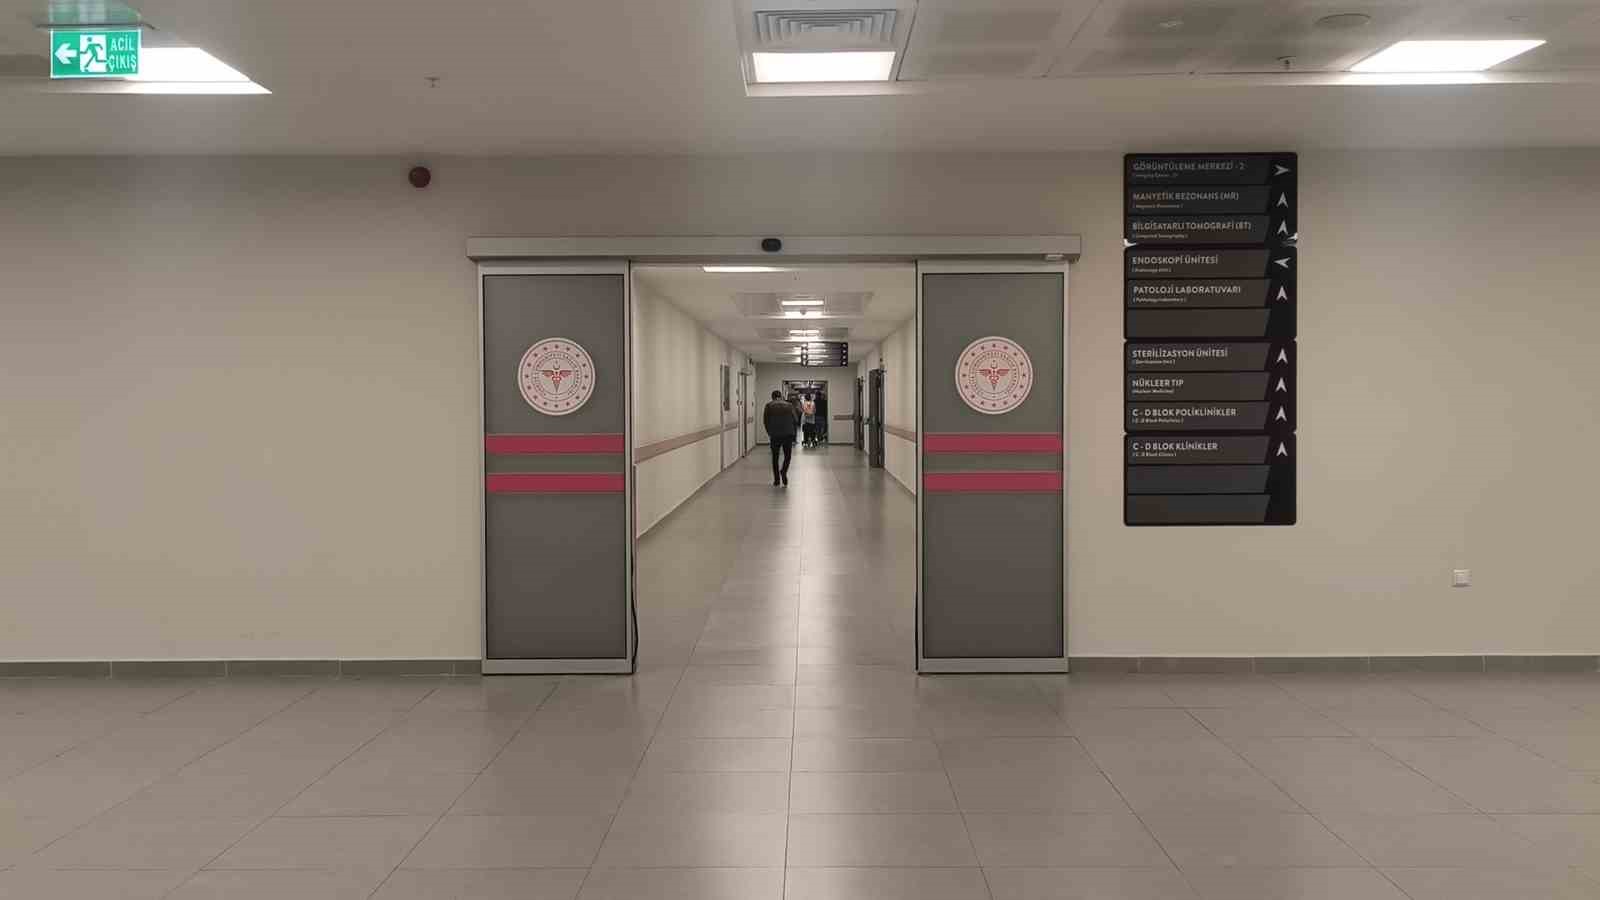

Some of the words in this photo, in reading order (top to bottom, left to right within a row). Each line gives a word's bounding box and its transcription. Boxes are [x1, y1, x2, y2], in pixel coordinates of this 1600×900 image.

[110, 35, 134, 51] ACİL
[108, 54, 136, 72] ÇIKIŞ
[1186, 221, 1234, 230] TOMOGRAFİ
[1132, 255, 1182, 264] ENDOSKOPİ
[1184, 254, 1218, 264] ÜNİTESİ
[1133, 285, 1174, 294] PATOLOJİ
[1176, 286, 1240, 294] LABORATUVARI
[1132, 348, 1194, 358] STERİLİZASYON
[1196, 348, 1228, 358] ÜNİTESİ
[1132, 378, 1170, 387] NÜKLEER
[1176, 408, 1236, 416] POLİKLİNİKLER
[1176, 441, 1218, 450] KLİNİKLER
